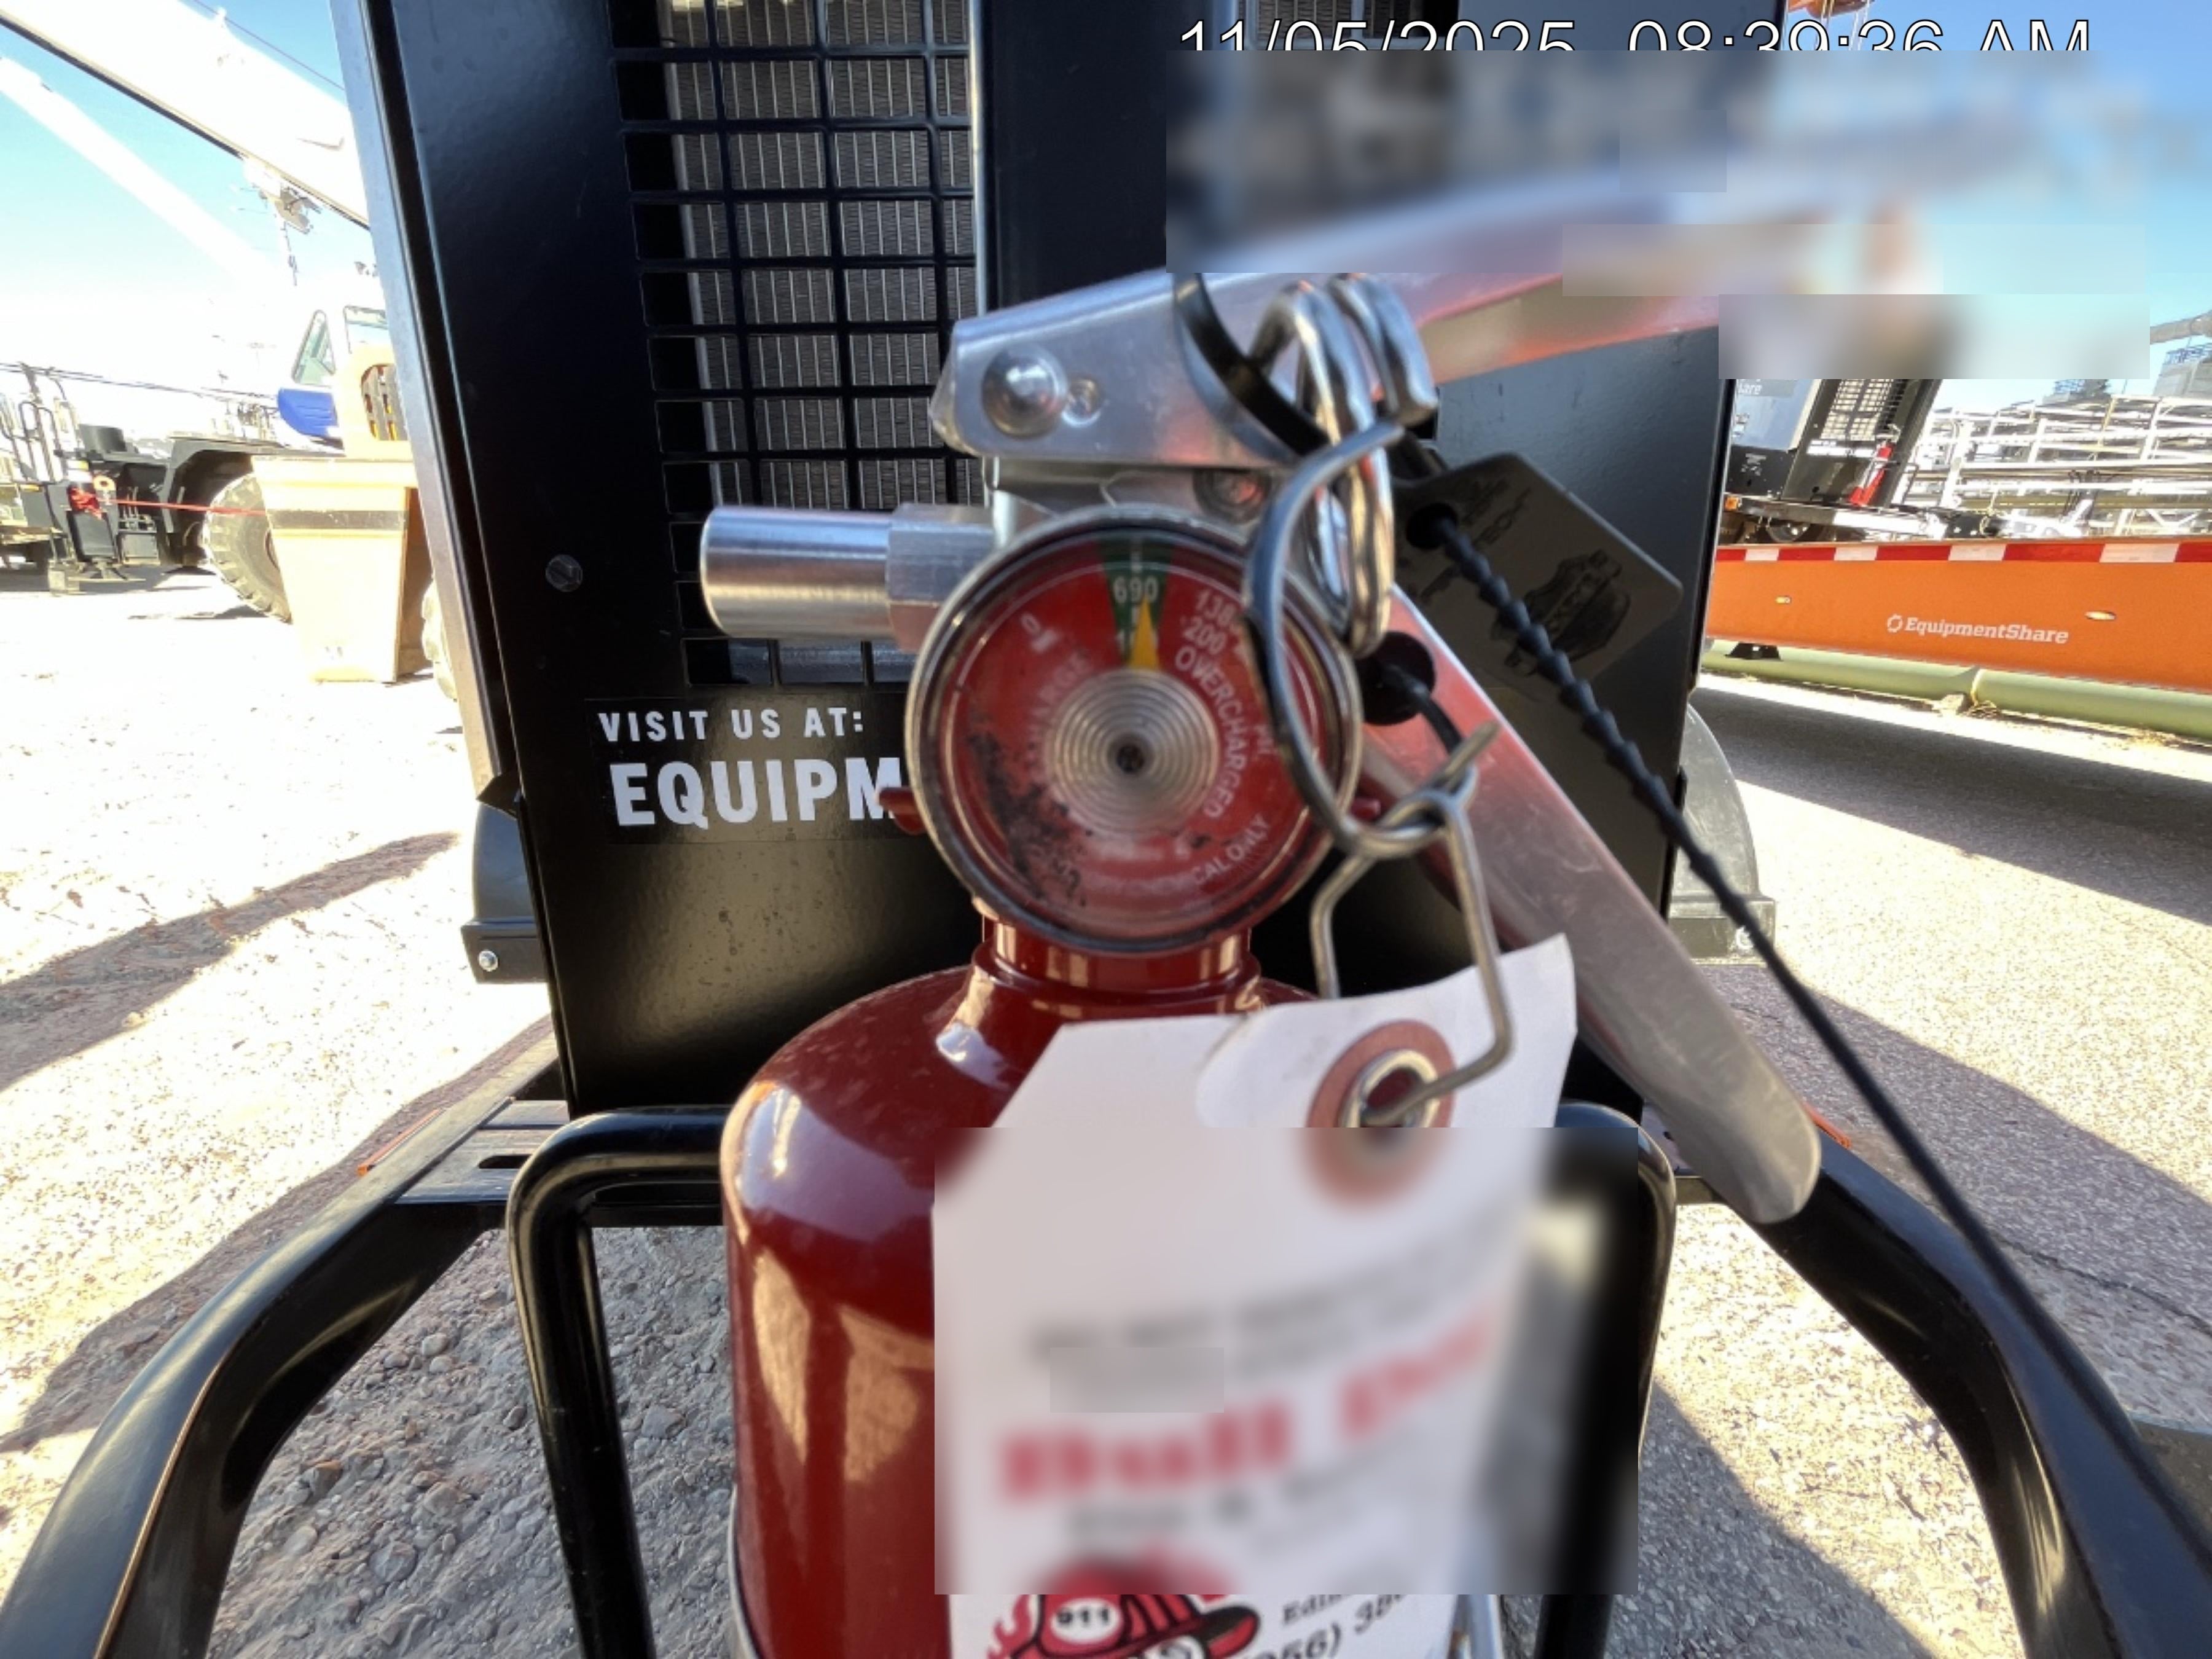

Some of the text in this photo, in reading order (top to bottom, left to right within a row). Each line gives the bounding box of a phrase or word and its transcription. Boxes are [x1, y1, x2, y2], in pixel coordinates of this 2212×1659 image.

[1113, 576, 1159, 604] 690
[1904, 616, 2069, 644] EquipmentShare
[598, 707, 863, 742] VISIT US AT:
[1175, 646, 1247, 818] OVERCHARGED
[610, 757, 902, 830] EQUIPM
